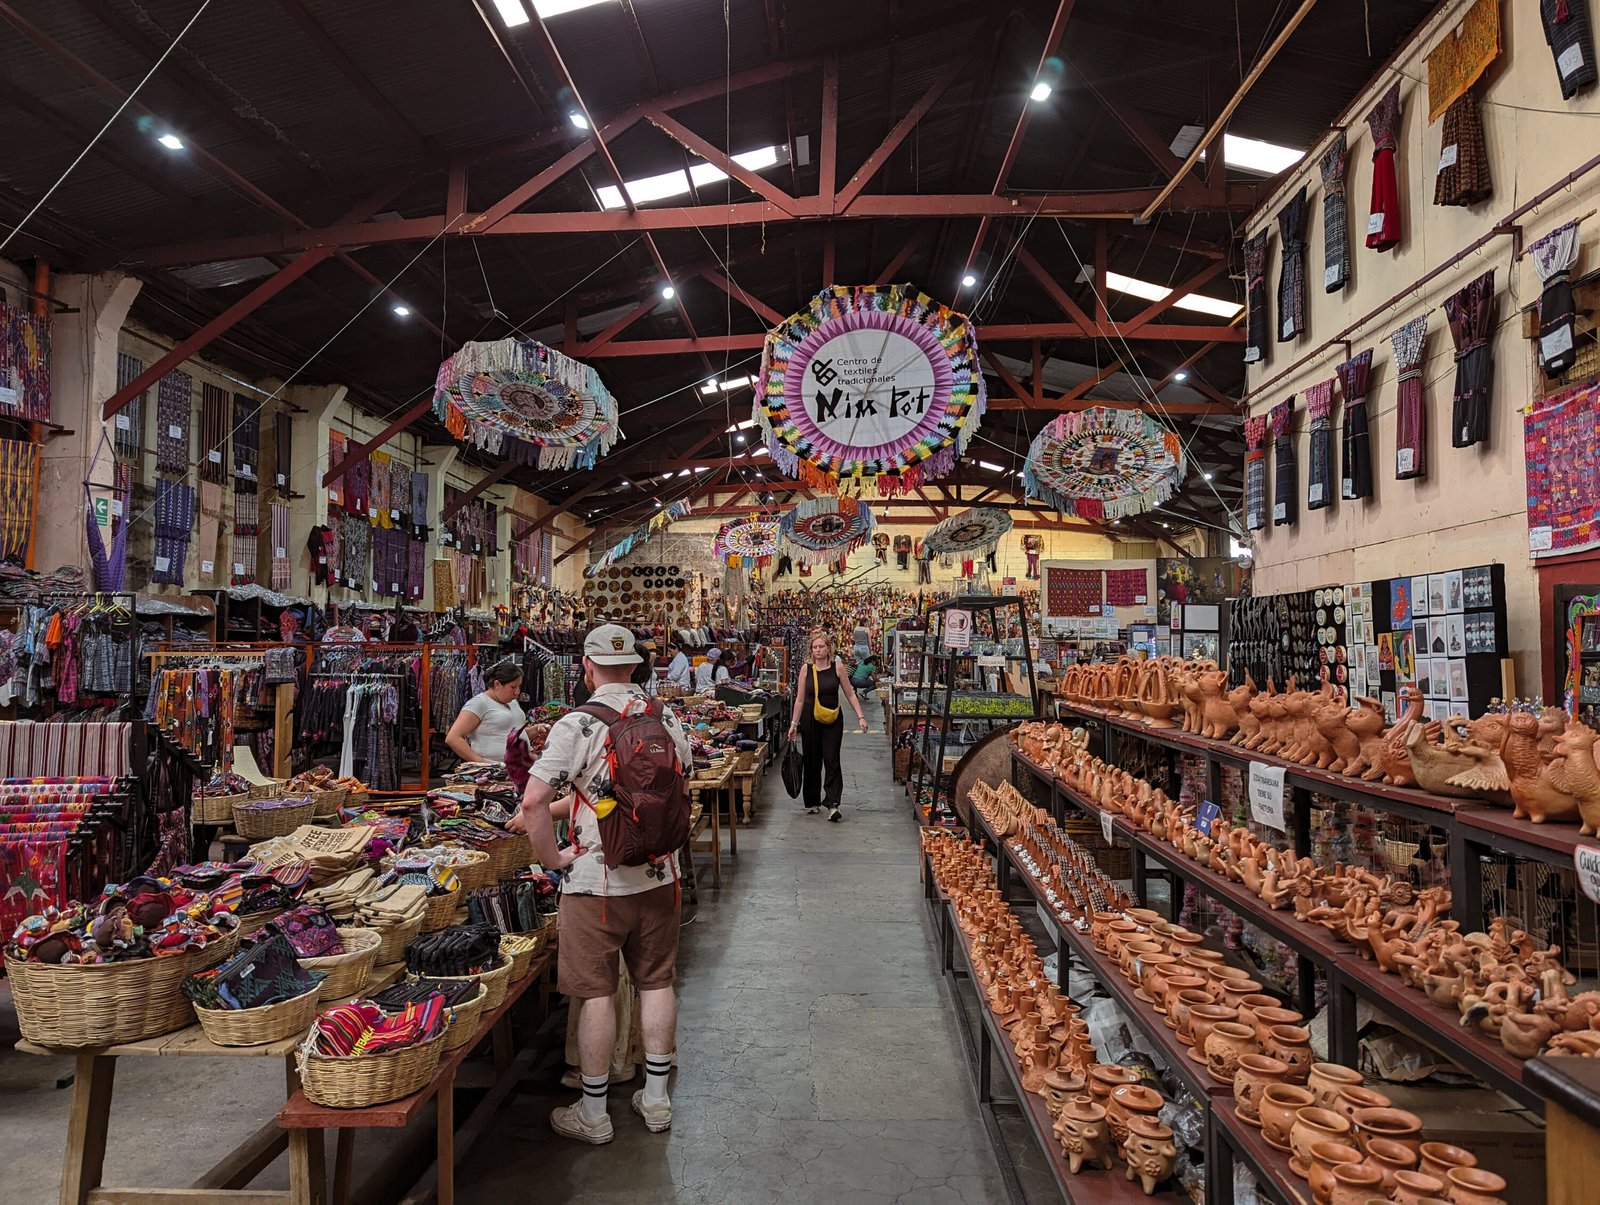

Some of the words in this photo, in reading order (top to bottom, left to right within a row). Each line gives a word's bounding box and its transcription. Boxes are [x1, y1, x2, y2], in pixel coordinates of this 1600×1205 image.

[836, 358, 868, 366] Centro
[870, 356, 883, 364] de
[843, 366, 878, 376] textiles
[837, 375, 896, 385] tradicionales
[815, 387, 878, 423] Nim
